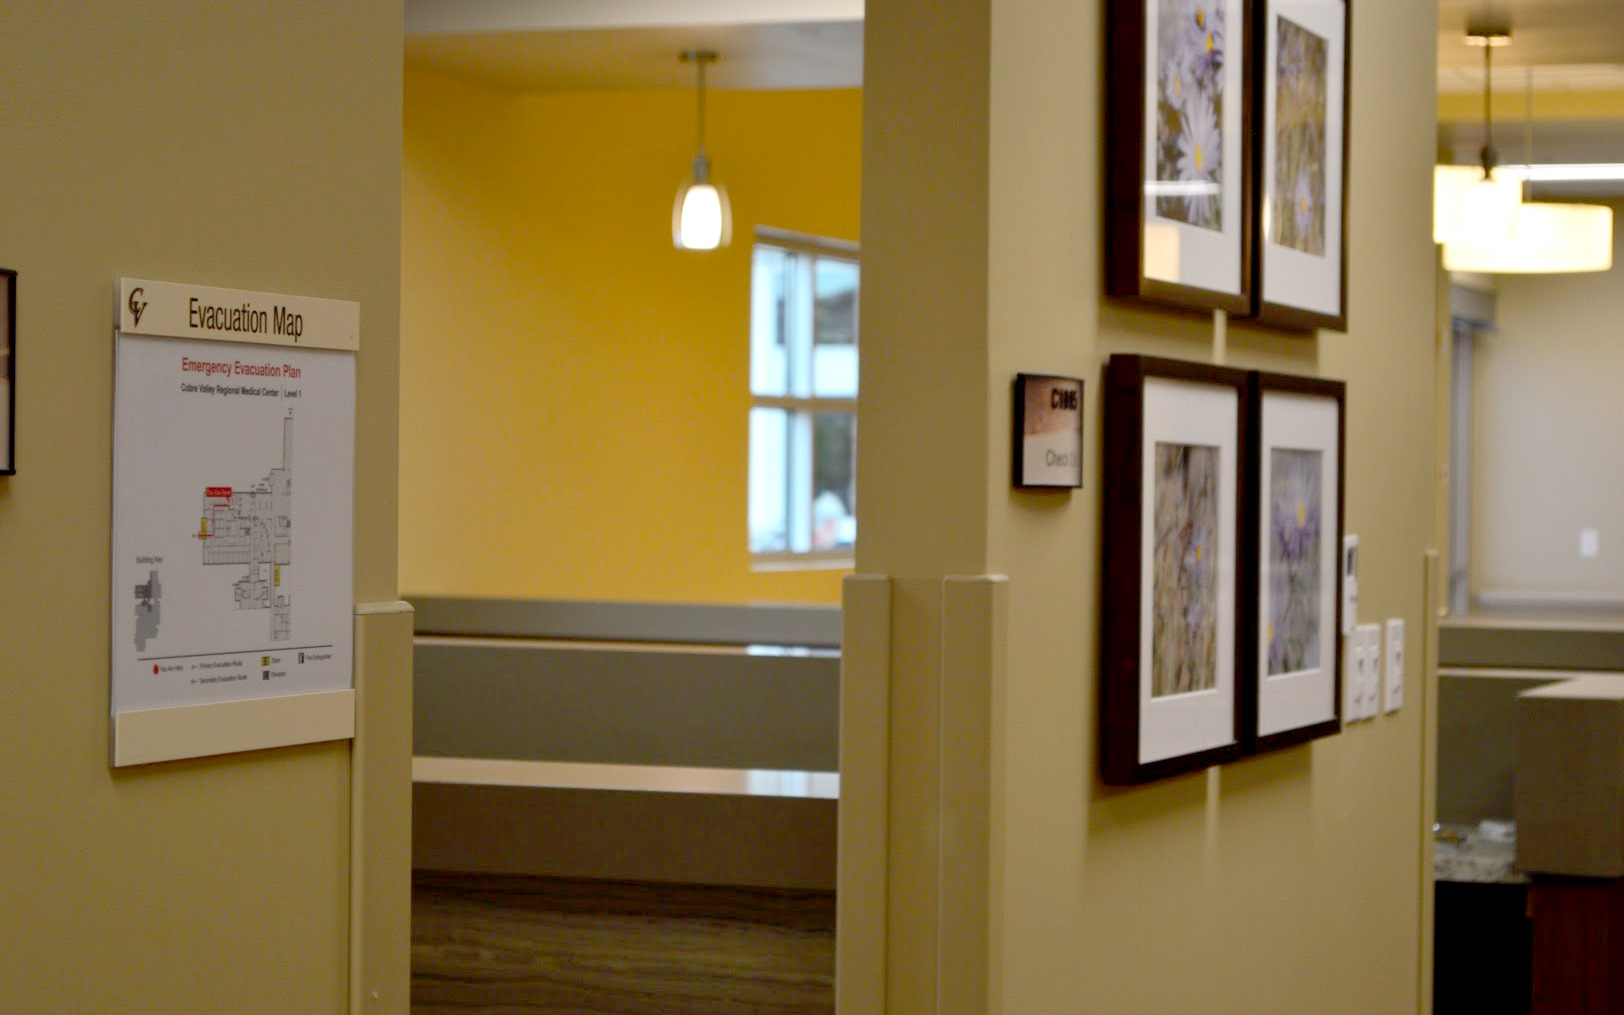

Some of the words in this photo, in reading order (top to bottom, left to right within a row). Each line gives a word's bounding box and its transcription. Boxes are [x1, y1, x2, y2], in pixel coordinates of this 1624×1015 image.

[189, 297, 267, 333] Evacuation
[273, 305, 303, 342] Map
[182, 357, 232, 377] Emergency
[234, 361, 281, 377] Evacuation
[283, 364, 301, 378] Plan
[181, 383, 198, 393] Cobre
[199, 384, 215, 395] Valley
[216, 385, 240, 396] Regional
[241, 387, 260, 396] Medical
[262, 388, 279, 396] Center
[284, 389, 298, 397] Level
